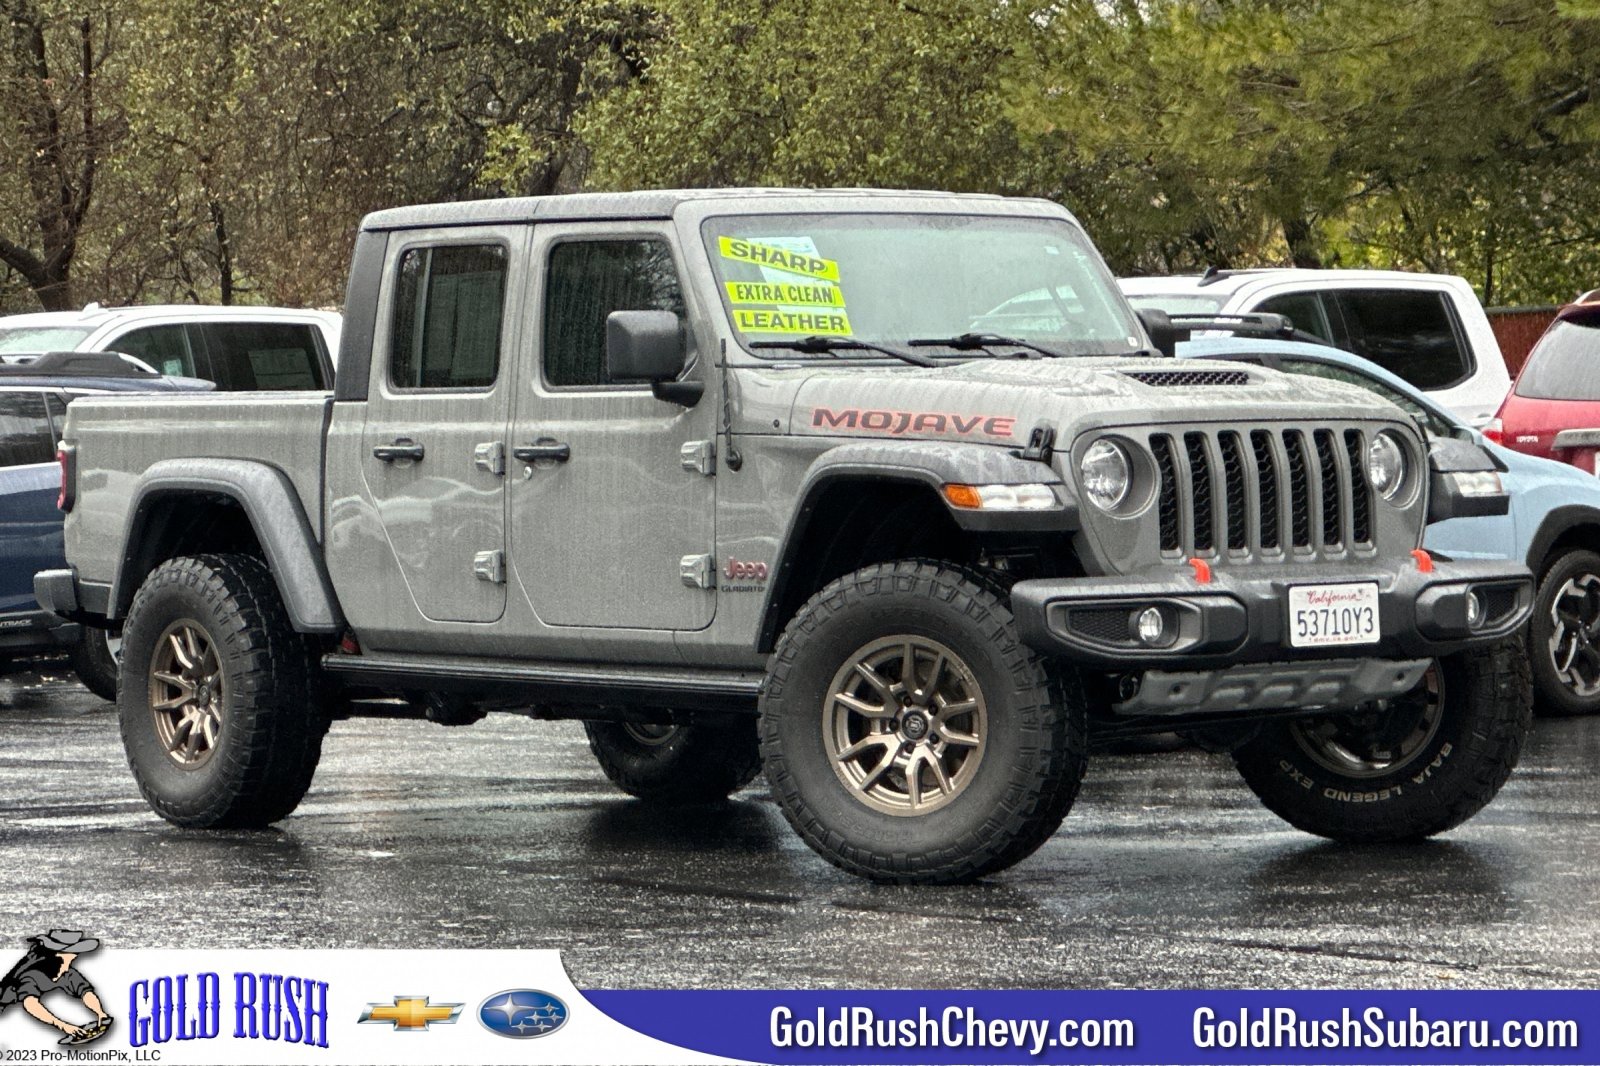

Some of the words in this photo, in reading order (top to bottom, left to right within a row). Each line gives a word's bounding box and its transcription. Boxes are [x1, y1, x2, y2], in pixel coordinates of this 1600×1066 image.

[730, 242, 828, 273] SHARP
[736, 284, 785, 301] EXTRA
[788, 285, 834, 303] CLEAN
[740, 313, 845, 331] LEATHER
[812, 408, 1016, 436] MOJAVE
[723, 556, 768, 582] Jeep
[1306, 589, 1363, 607] California
[1297, 607, 1374, 637] 53710Y3
[1279, 759, 1315, 790] EXP
[1411, 742, 1453, 785] BAJA
[1323, 785, 1403, 803] LEGEND
